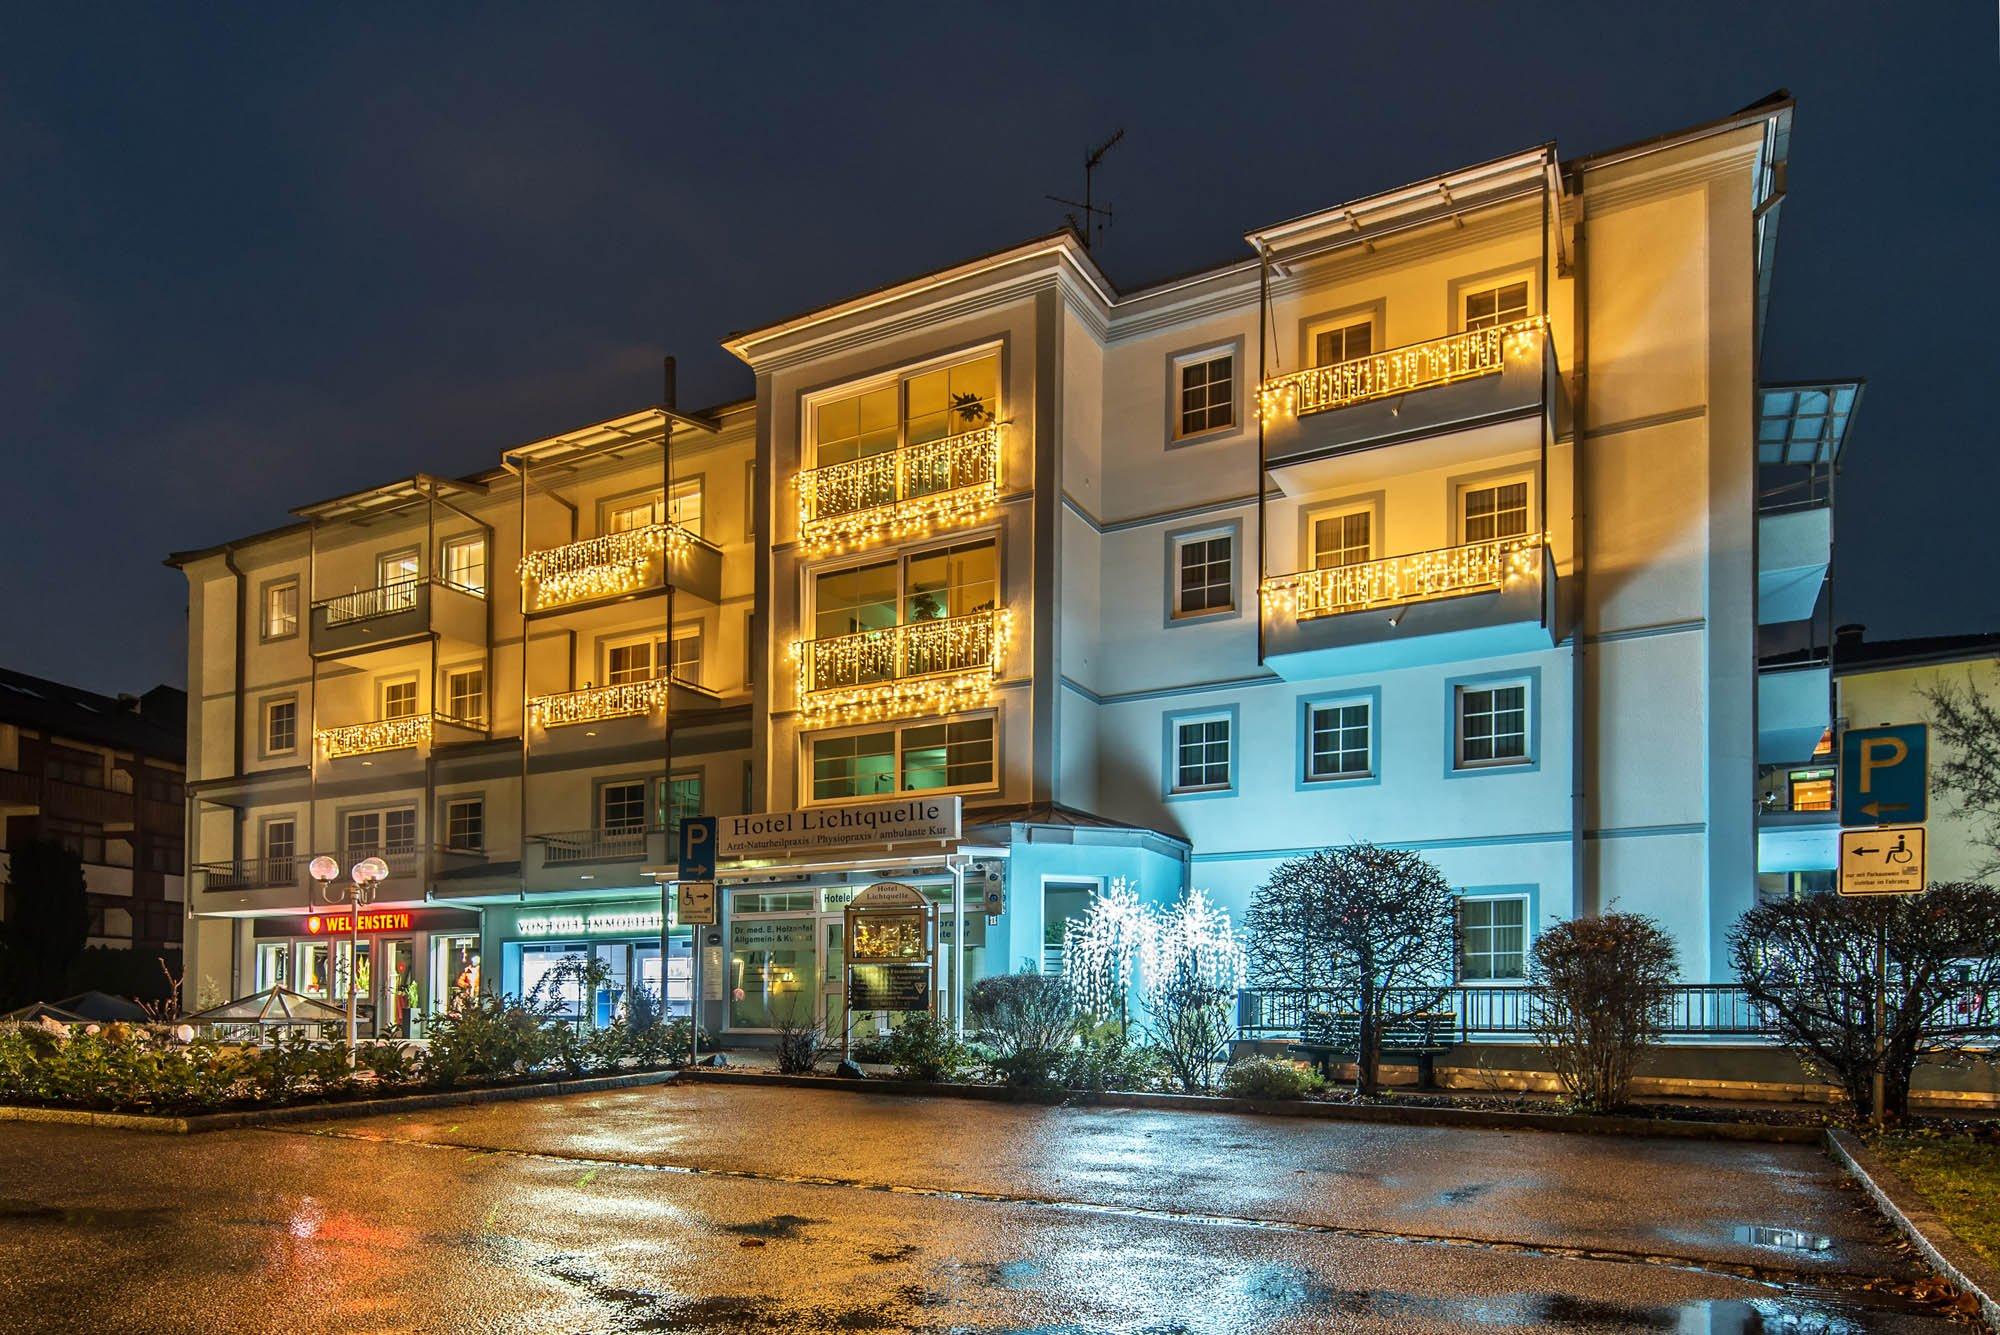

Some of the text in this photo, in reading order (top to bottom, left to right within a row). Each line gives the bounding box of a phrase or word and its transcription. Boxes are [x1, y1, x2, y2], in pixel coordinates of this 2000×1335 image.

[1859, 737, 1908, 793] P
[733, 802, 939, 836] Hotel Lichtquelle
[686, 823, 708, 860] P
[726, 837, 810, 851] Arzt-Naturheilpraxis
[817, 832, 872, 847] Physiopraxis
[879, 827, 926, 840] ambulante
[928, 825, 947, 836] Kur
[866, 892, 909, 901] Lichtquelle
[877, 885, 898, 893] Hotel
[326, 914, 409, 931] WELENSTEYN
[734, 926, 744, 935] Dr.
[746, 926, 765, 934] med.
